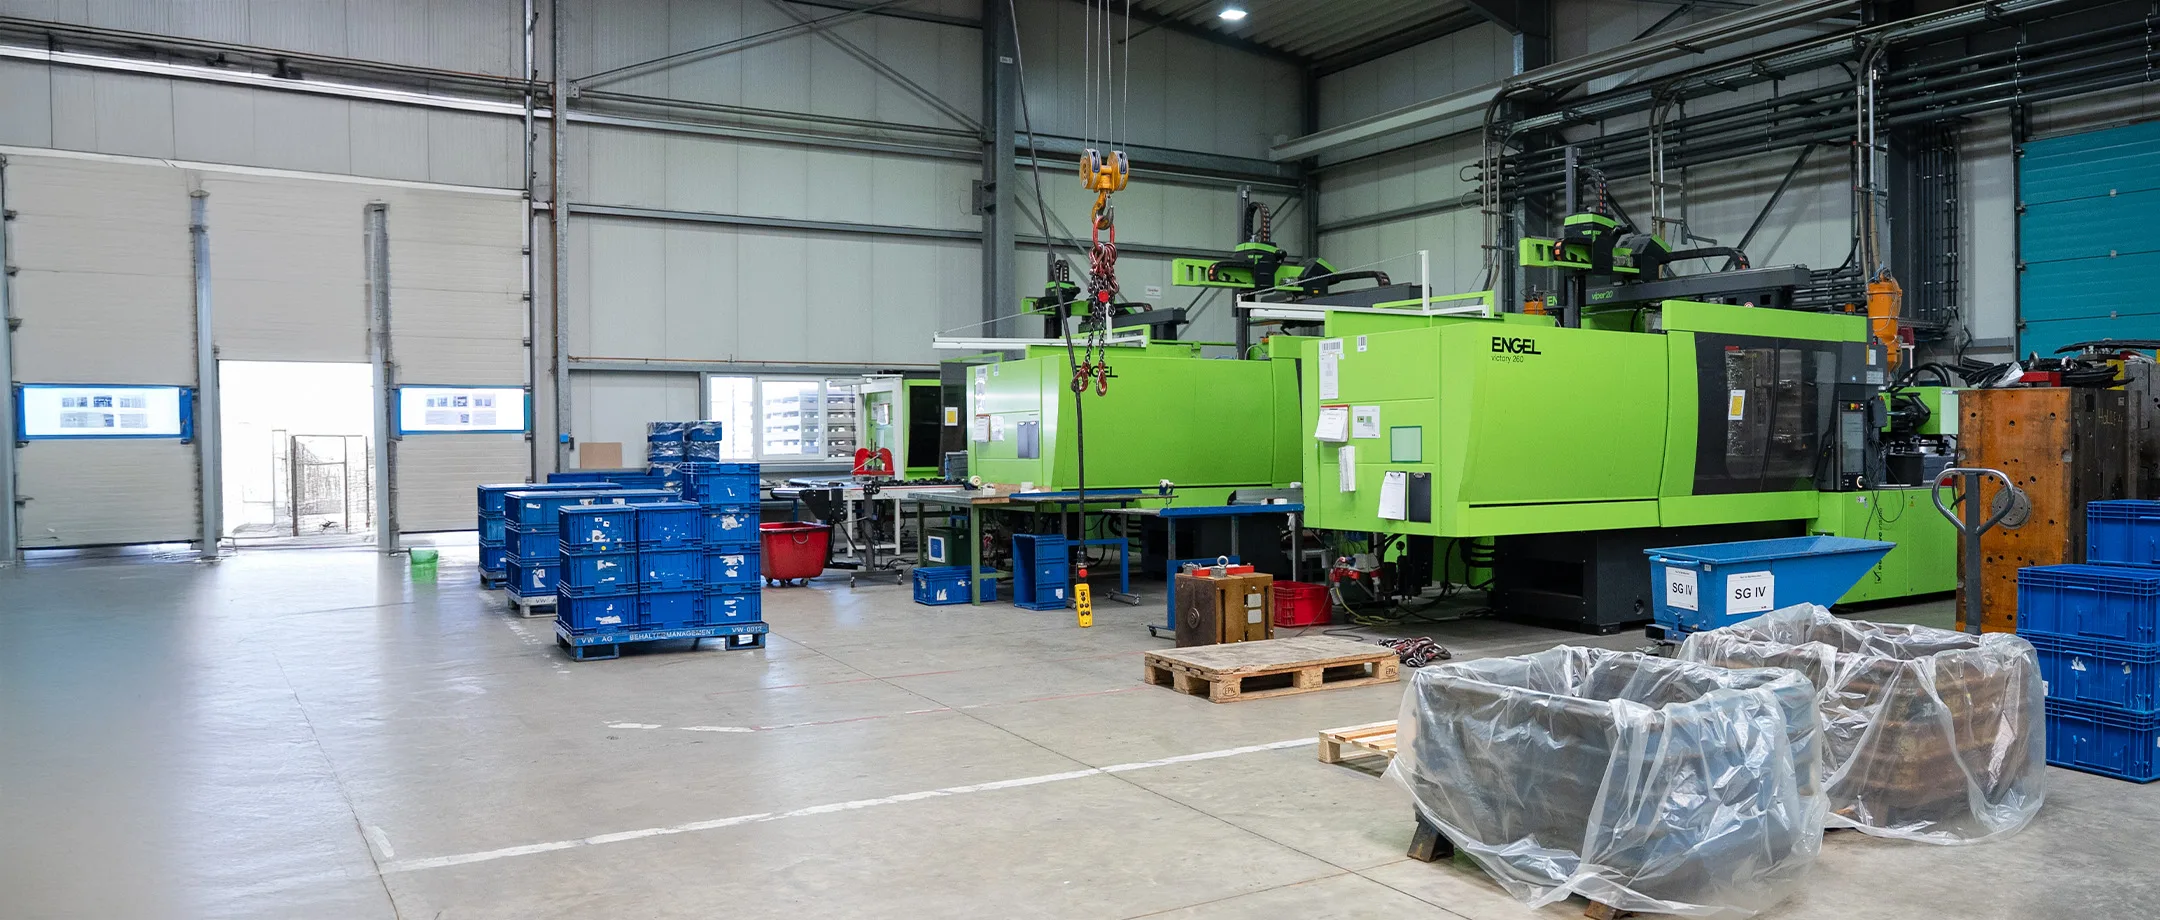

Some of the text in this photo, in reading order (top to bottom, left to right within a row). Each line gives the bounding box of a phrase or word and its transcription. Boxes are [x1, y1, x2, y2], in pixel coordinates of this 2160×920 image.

[1492, 336, 1541, 355] ENGEL
[1491, 354, 1524, 364] victory 260
[1672, 582, 1693, 596] SG IV
[1735, 586, 1766, 600] SG IV
[581, 636, 595, 644] VW
[601, 635, 613, 643] AG
